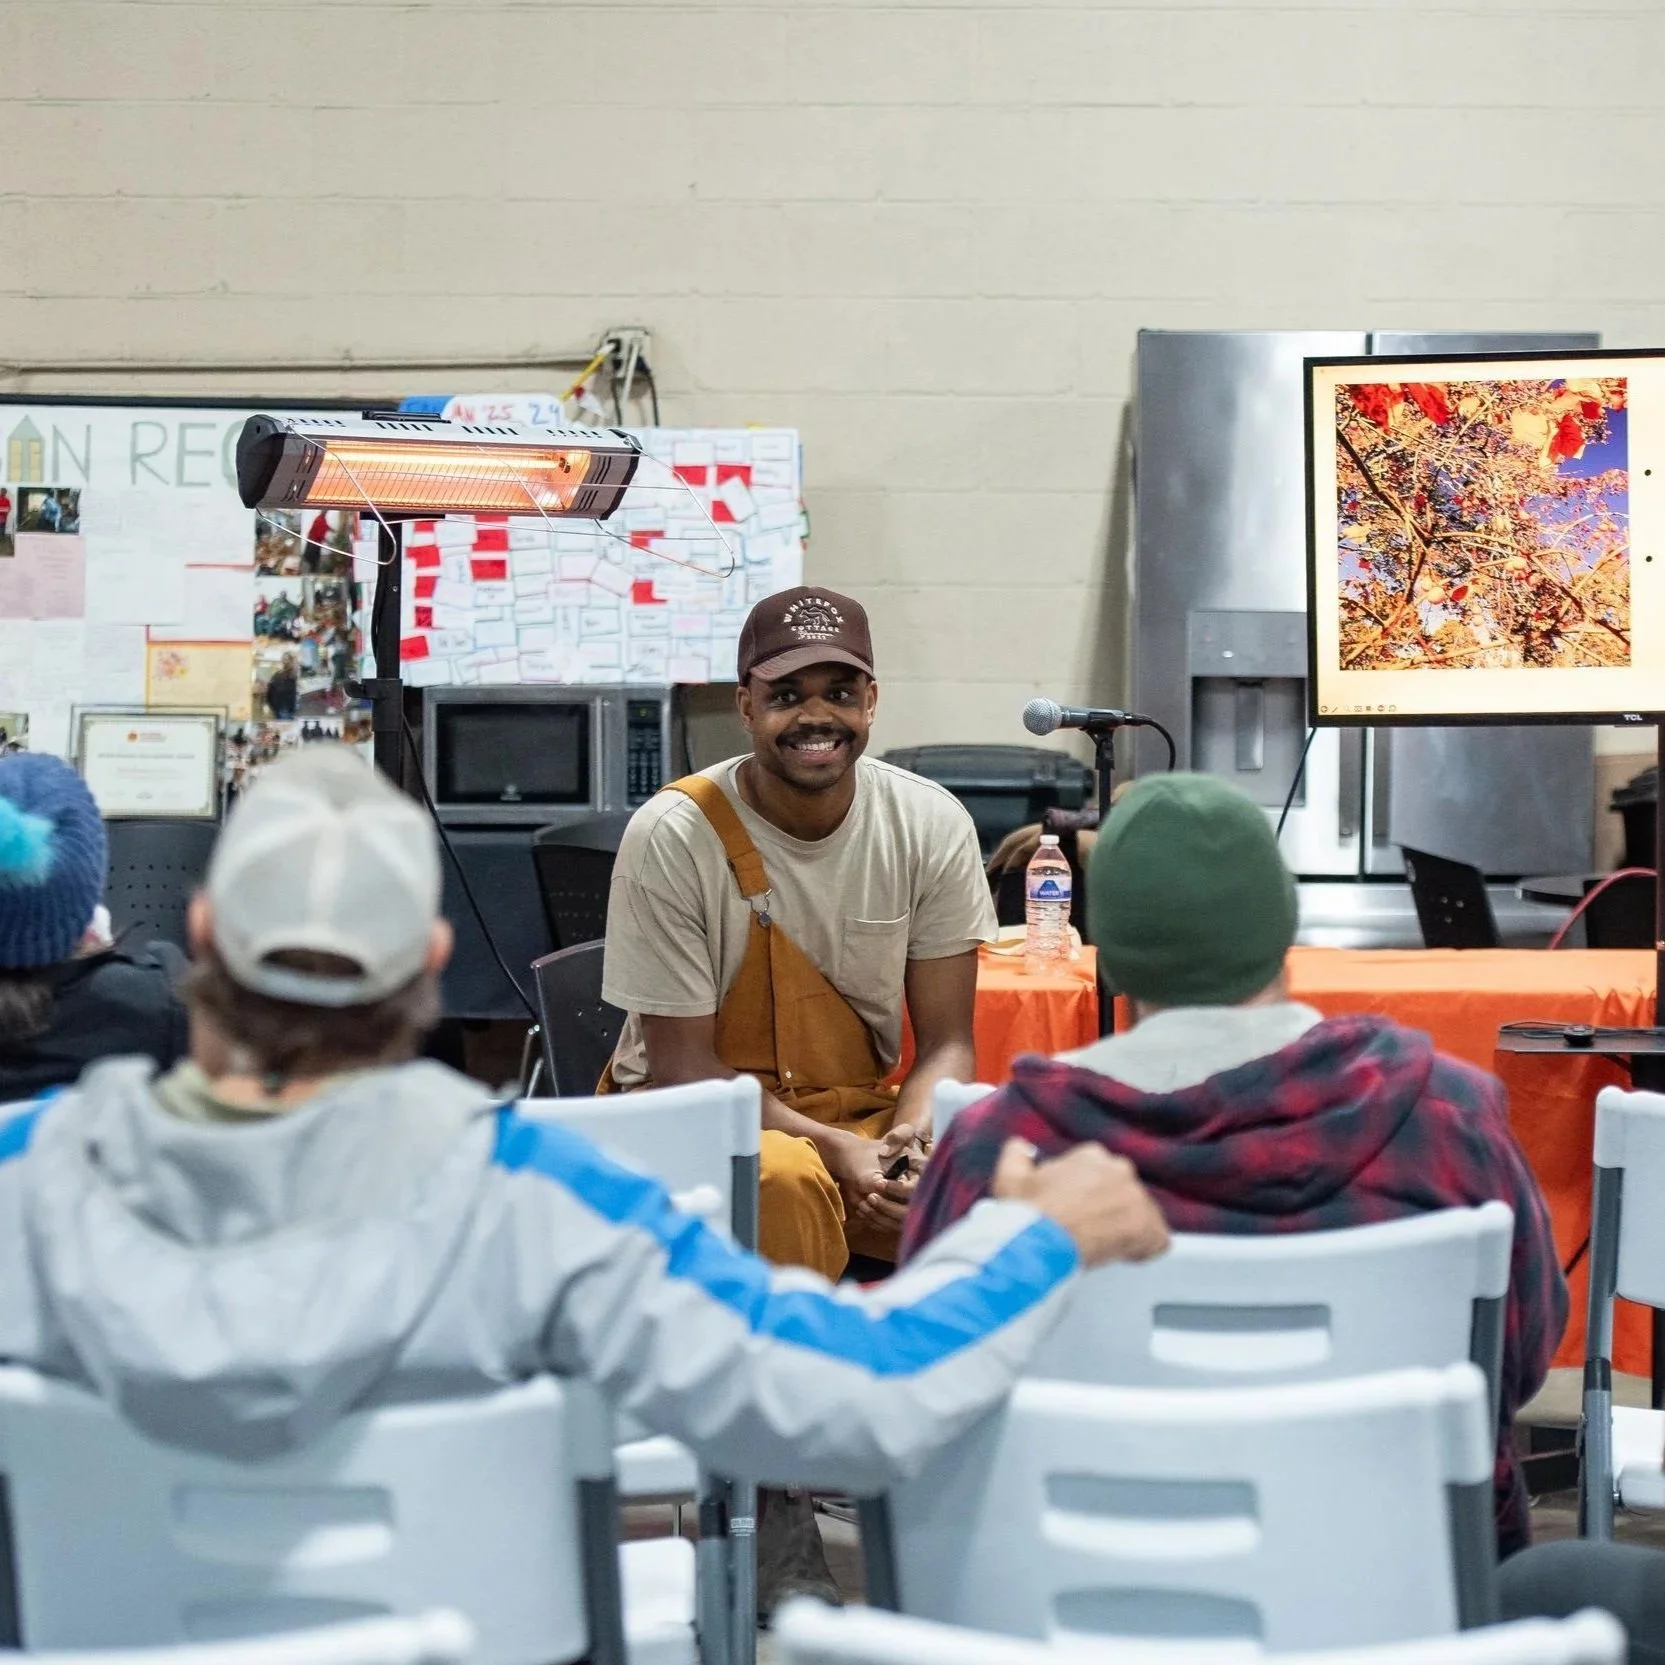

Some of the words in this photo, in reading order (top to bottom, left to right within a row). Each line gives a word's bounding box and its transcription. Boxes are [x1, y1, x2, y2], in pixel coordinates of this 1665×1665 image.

[783, 597, 844, 623] WHITEFOX
[791, 625, 840, 633] COTTAGE
[1624, 713, 1643, 721] TCL
